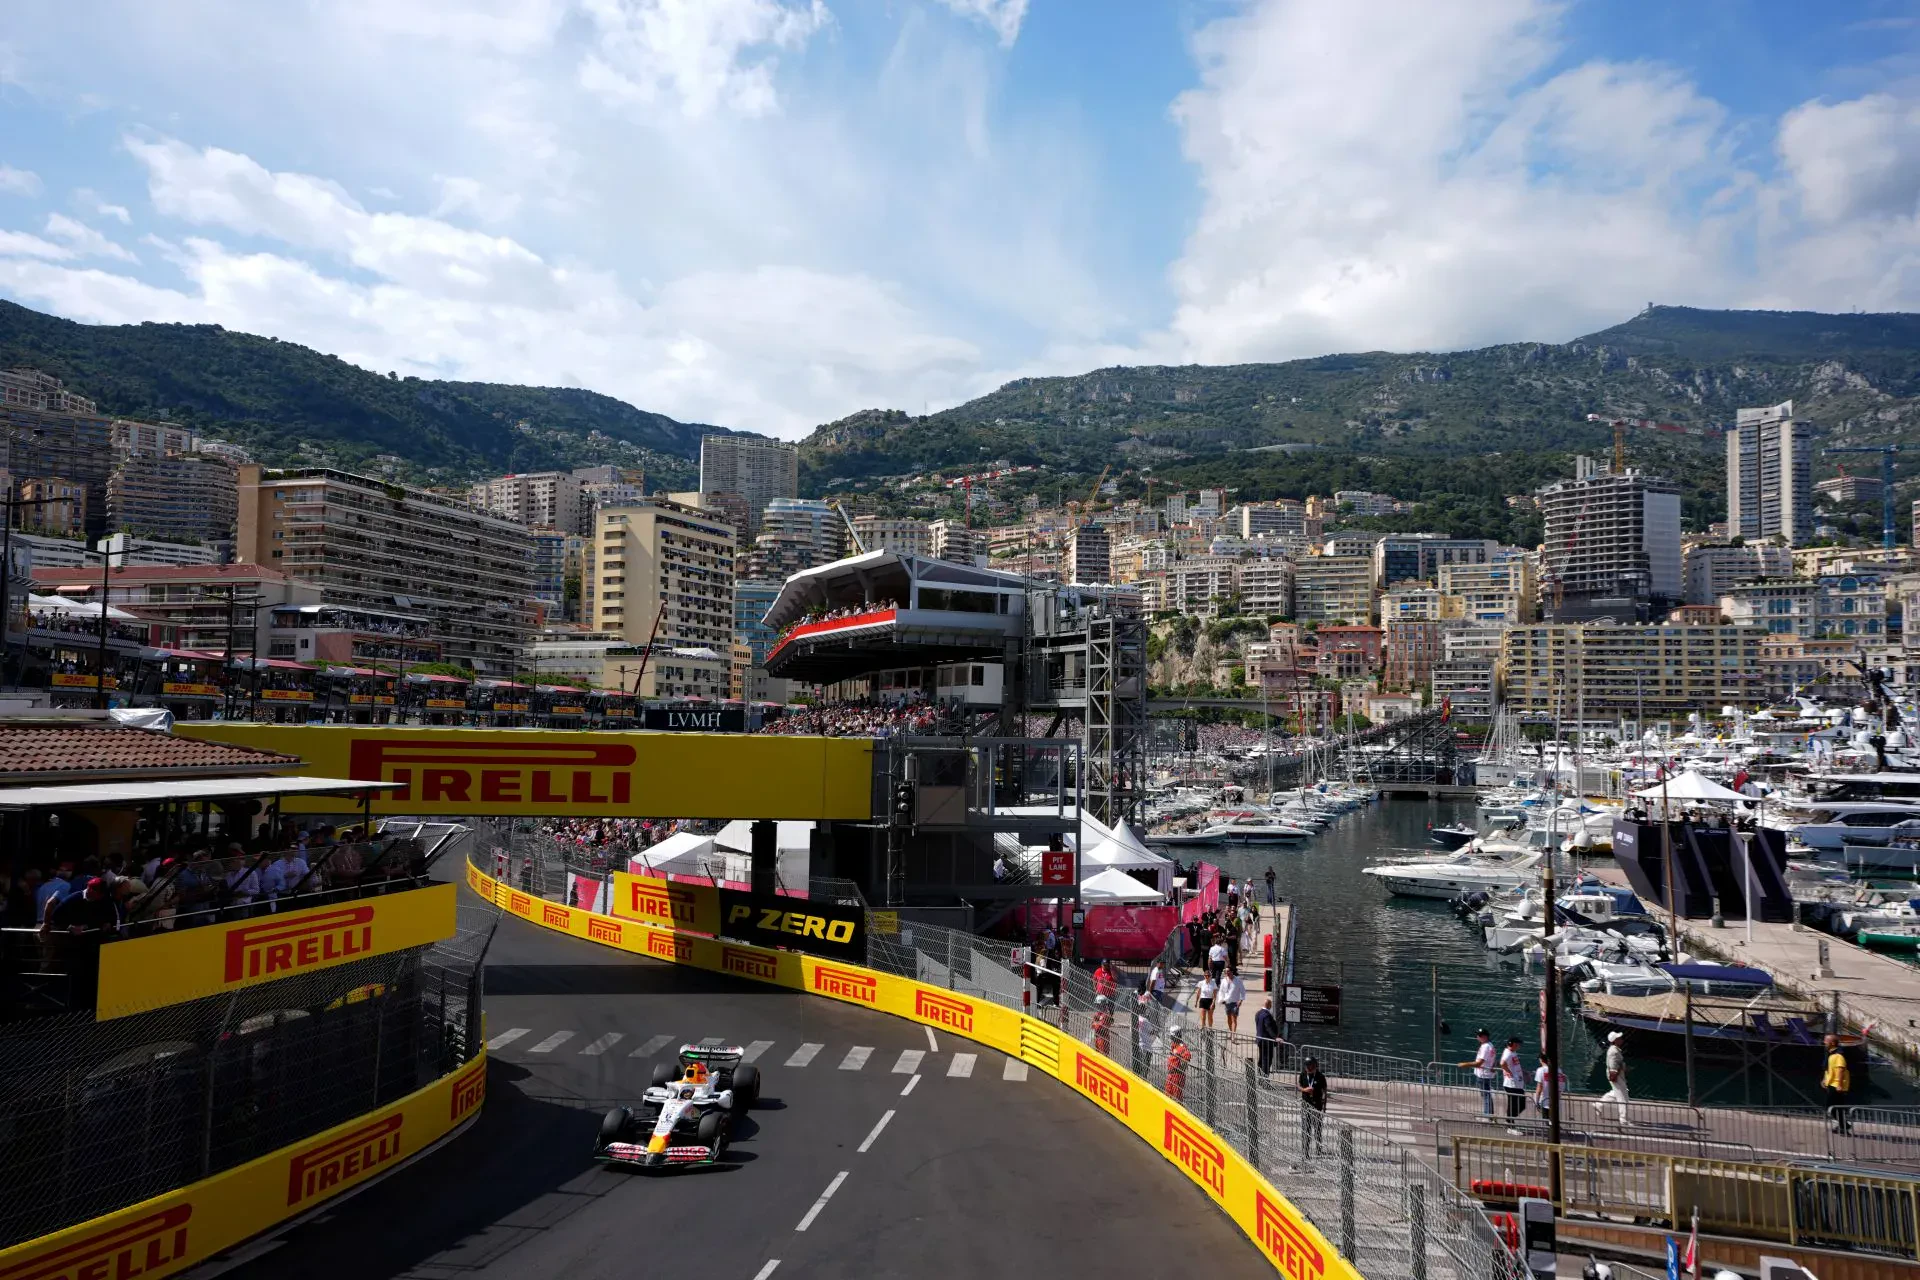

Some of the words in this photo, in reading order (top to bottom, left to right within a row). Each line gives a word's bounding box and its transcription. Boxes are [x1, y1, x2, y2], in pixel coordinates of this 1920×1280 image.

[668, 712, 721, 727] LVMH
[350, 739, 637, 803] PIRELLI
[544, 904, 570, 929] PIRELLI
[631, 881, 697, 923] PIRELLI
[588, 917, 622, 944] PIRELLI
[728, 904, 751, 924] P
[757, 909, 855, 944] ZERO
[225, 906, 374, 983] PIRELLI
[648, 931, 694, 961] PIRELLI
[721, 946, 778, 980] PIRELLI
[815, 965, 877, 1003] PIRELLI
[915, 989, 974, 1032] PIRELLI
[1076, 1048, 1129, 1116] PIRELLI
[288, 1113, 403, 1206] PIRELLI
[671, 1147, 707, 1155] HUGO
[1163, 1109, 1225, 1198] PIRELLI
